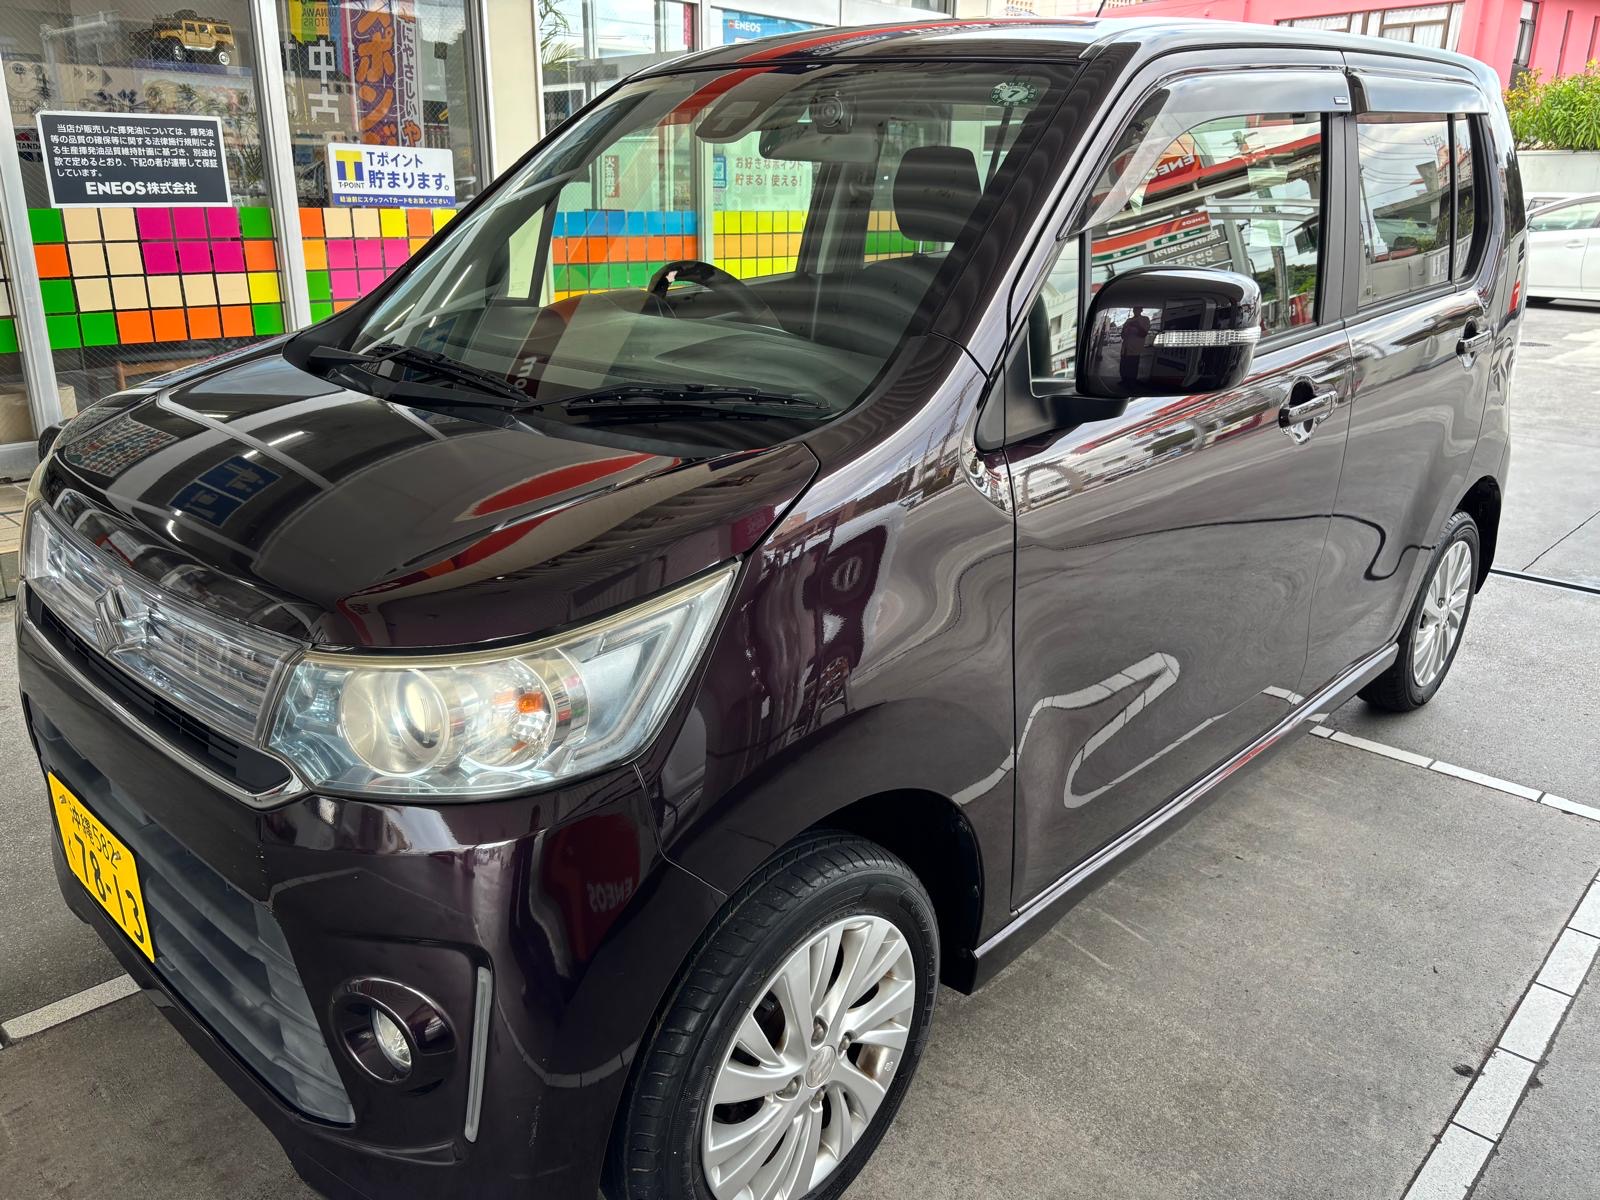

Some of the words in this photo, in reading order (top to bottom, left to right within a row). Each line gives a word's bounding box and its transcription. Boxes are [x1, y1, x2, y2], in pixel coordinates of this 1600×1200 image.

[735, 19, 761, 33] ENEOS
[366, 151, 423, 168] Tポイント
[57, 168, 103, 177] しています。
[338, 181, 365, 189] T-POINT
[368, 169, 450, 191] 貯まります。
[85, 181, 198, 196] ENEOS株式会社
